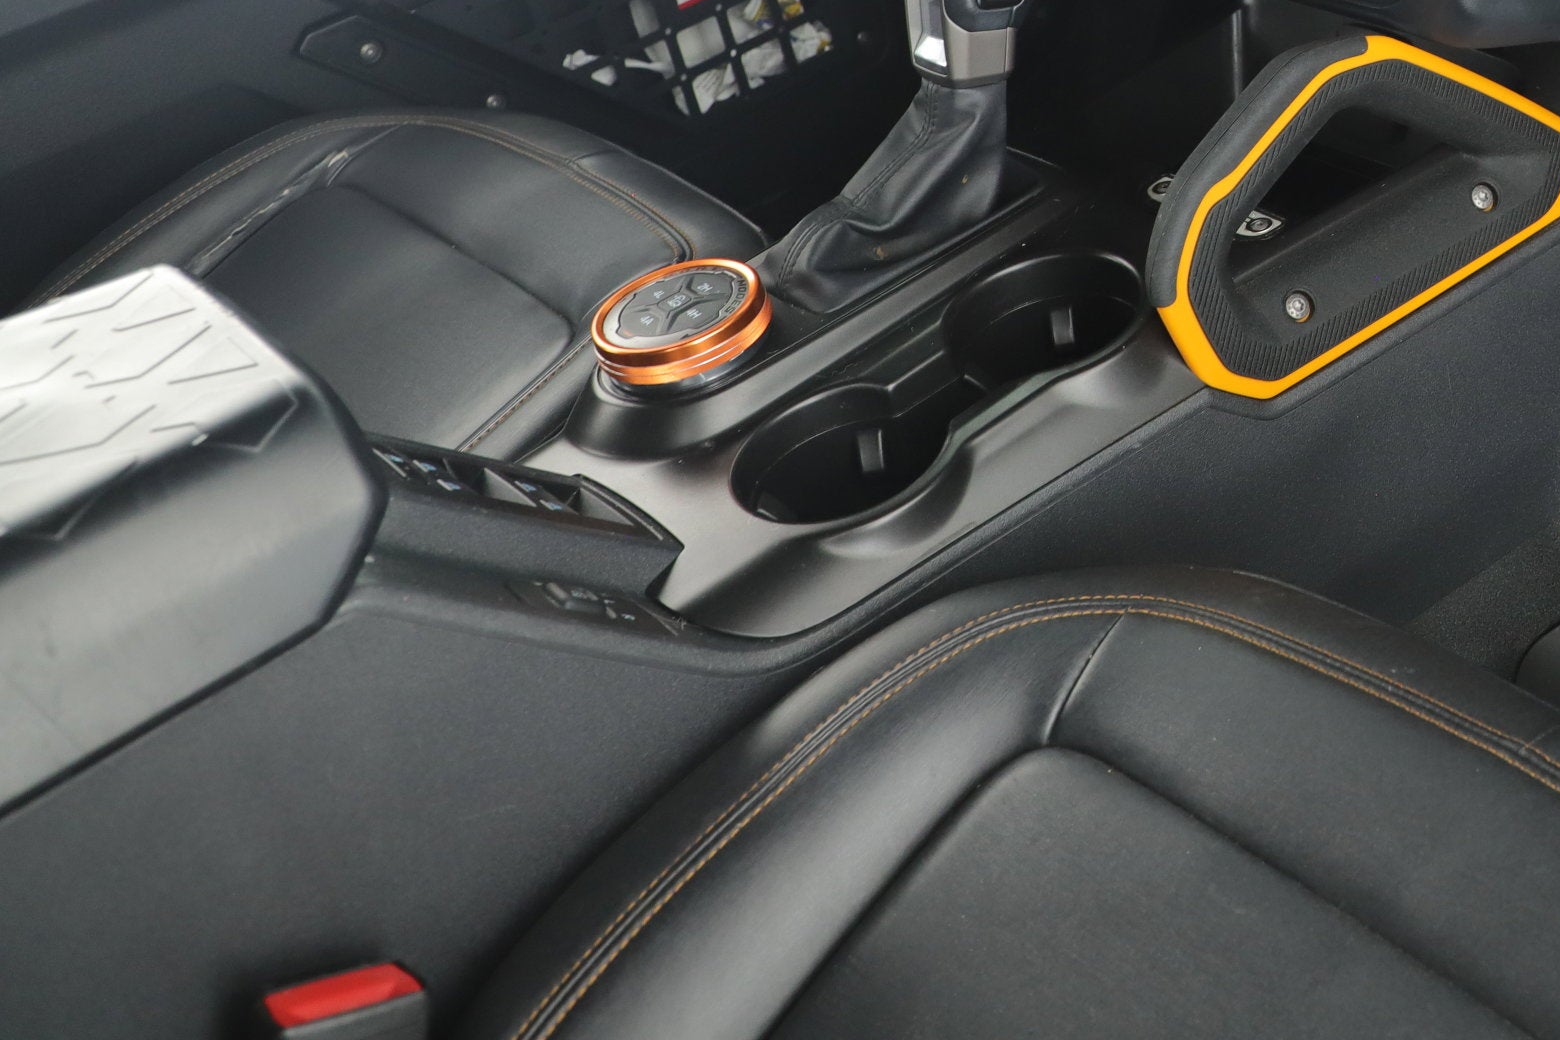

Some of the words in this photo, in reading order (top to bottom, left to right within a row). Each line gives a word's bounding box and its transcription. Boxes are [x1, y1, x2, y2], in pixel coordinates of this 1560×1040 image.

[697, 282, 713, 293] 2H
[654, 290, 665, 299] 4L
[726, 279, 748, 314] MODES
[687, 308, 702, 319] 4H
[640, 316, 654, 326] 4A
